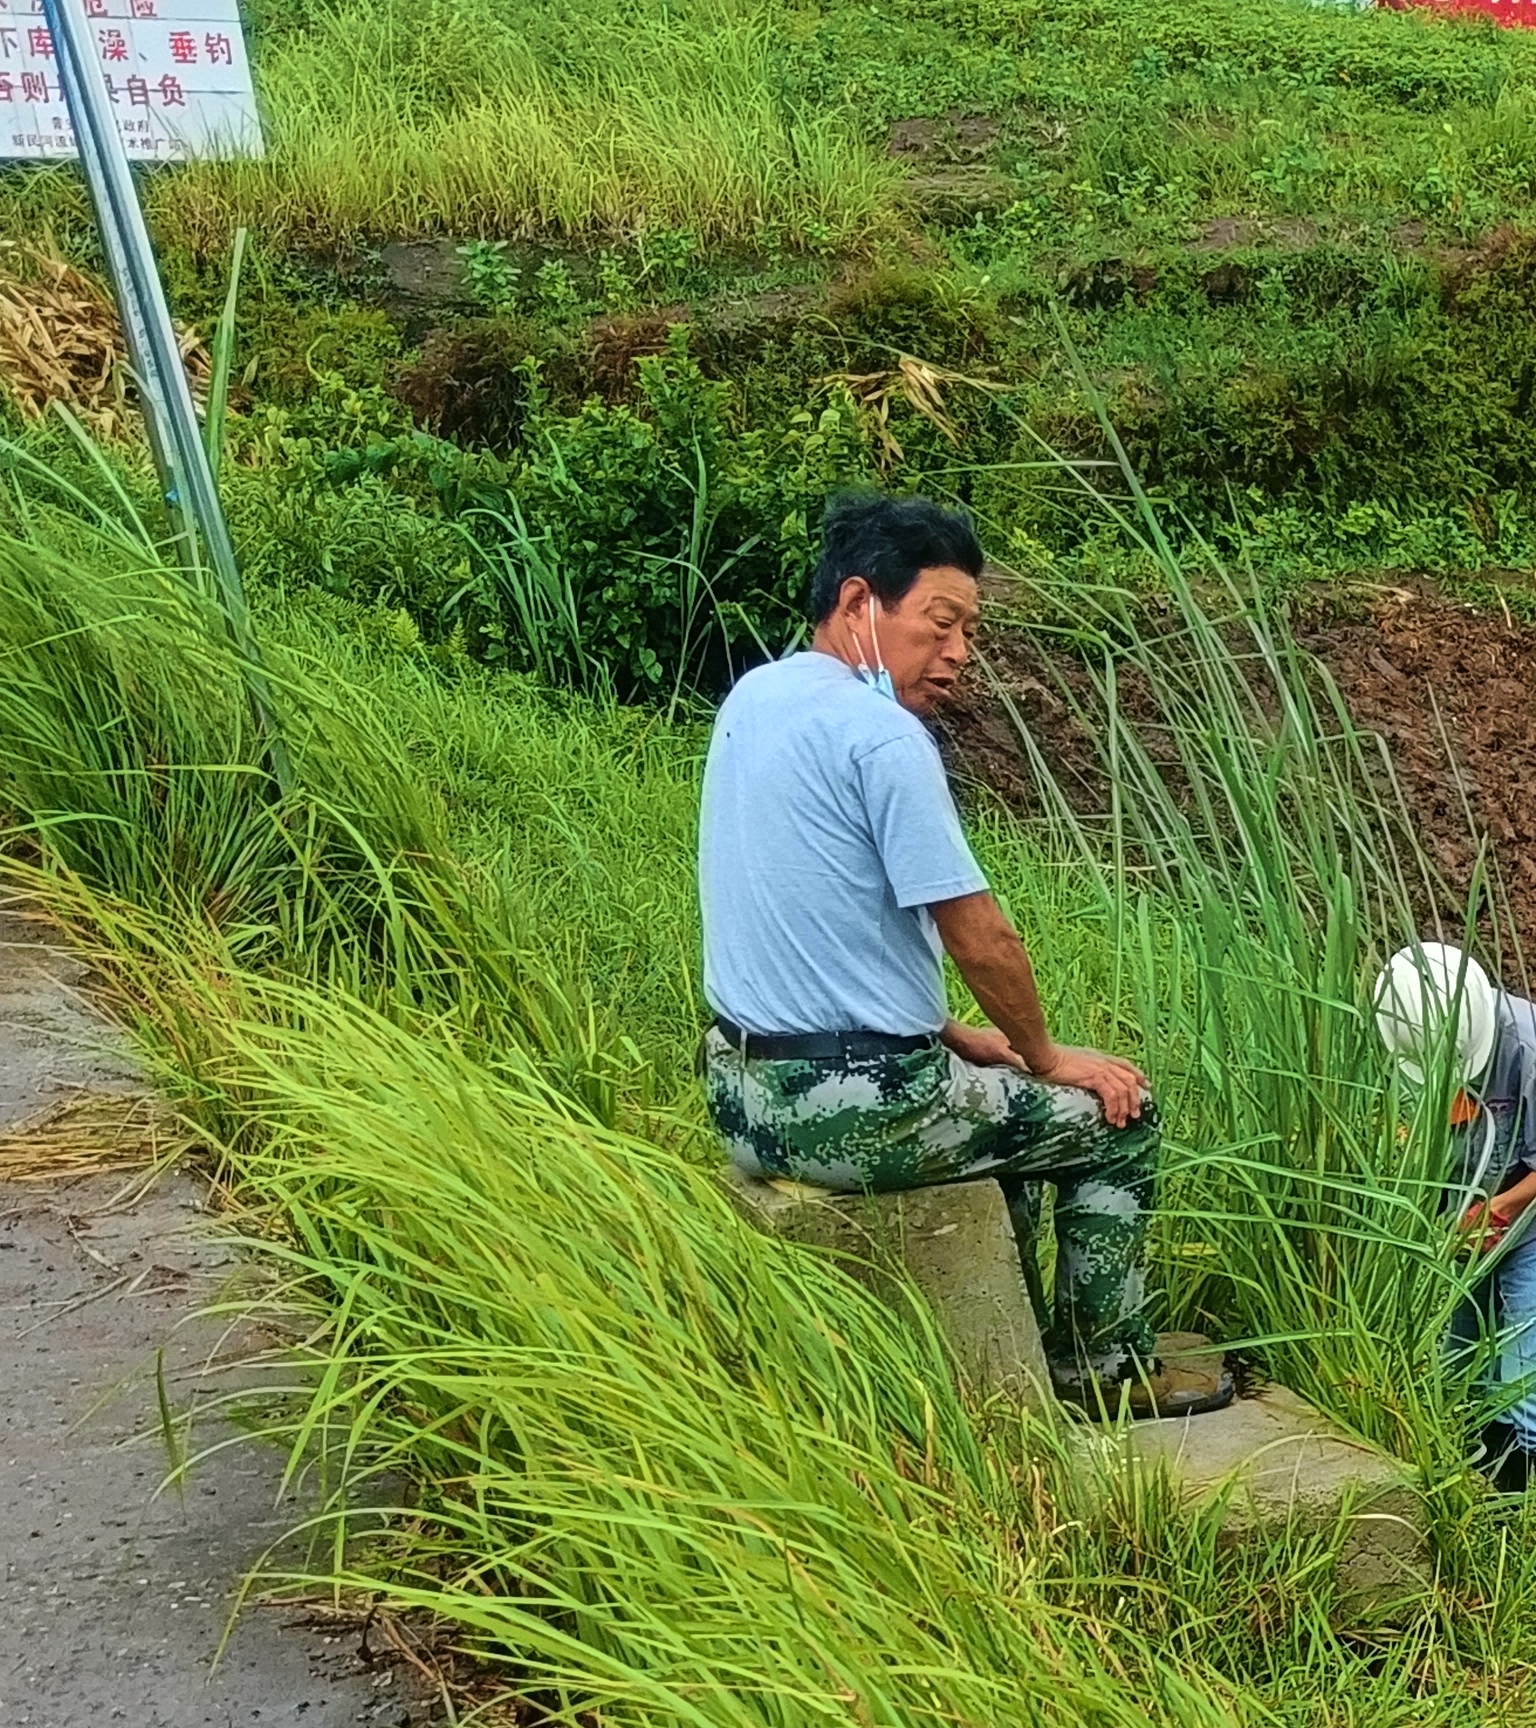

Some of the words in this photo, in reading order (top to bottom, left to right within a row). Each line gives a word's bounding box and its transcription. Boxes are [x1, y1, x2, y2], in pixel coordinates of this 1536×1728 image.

[0, 26, 233, 65] 下库澡、垂钓
